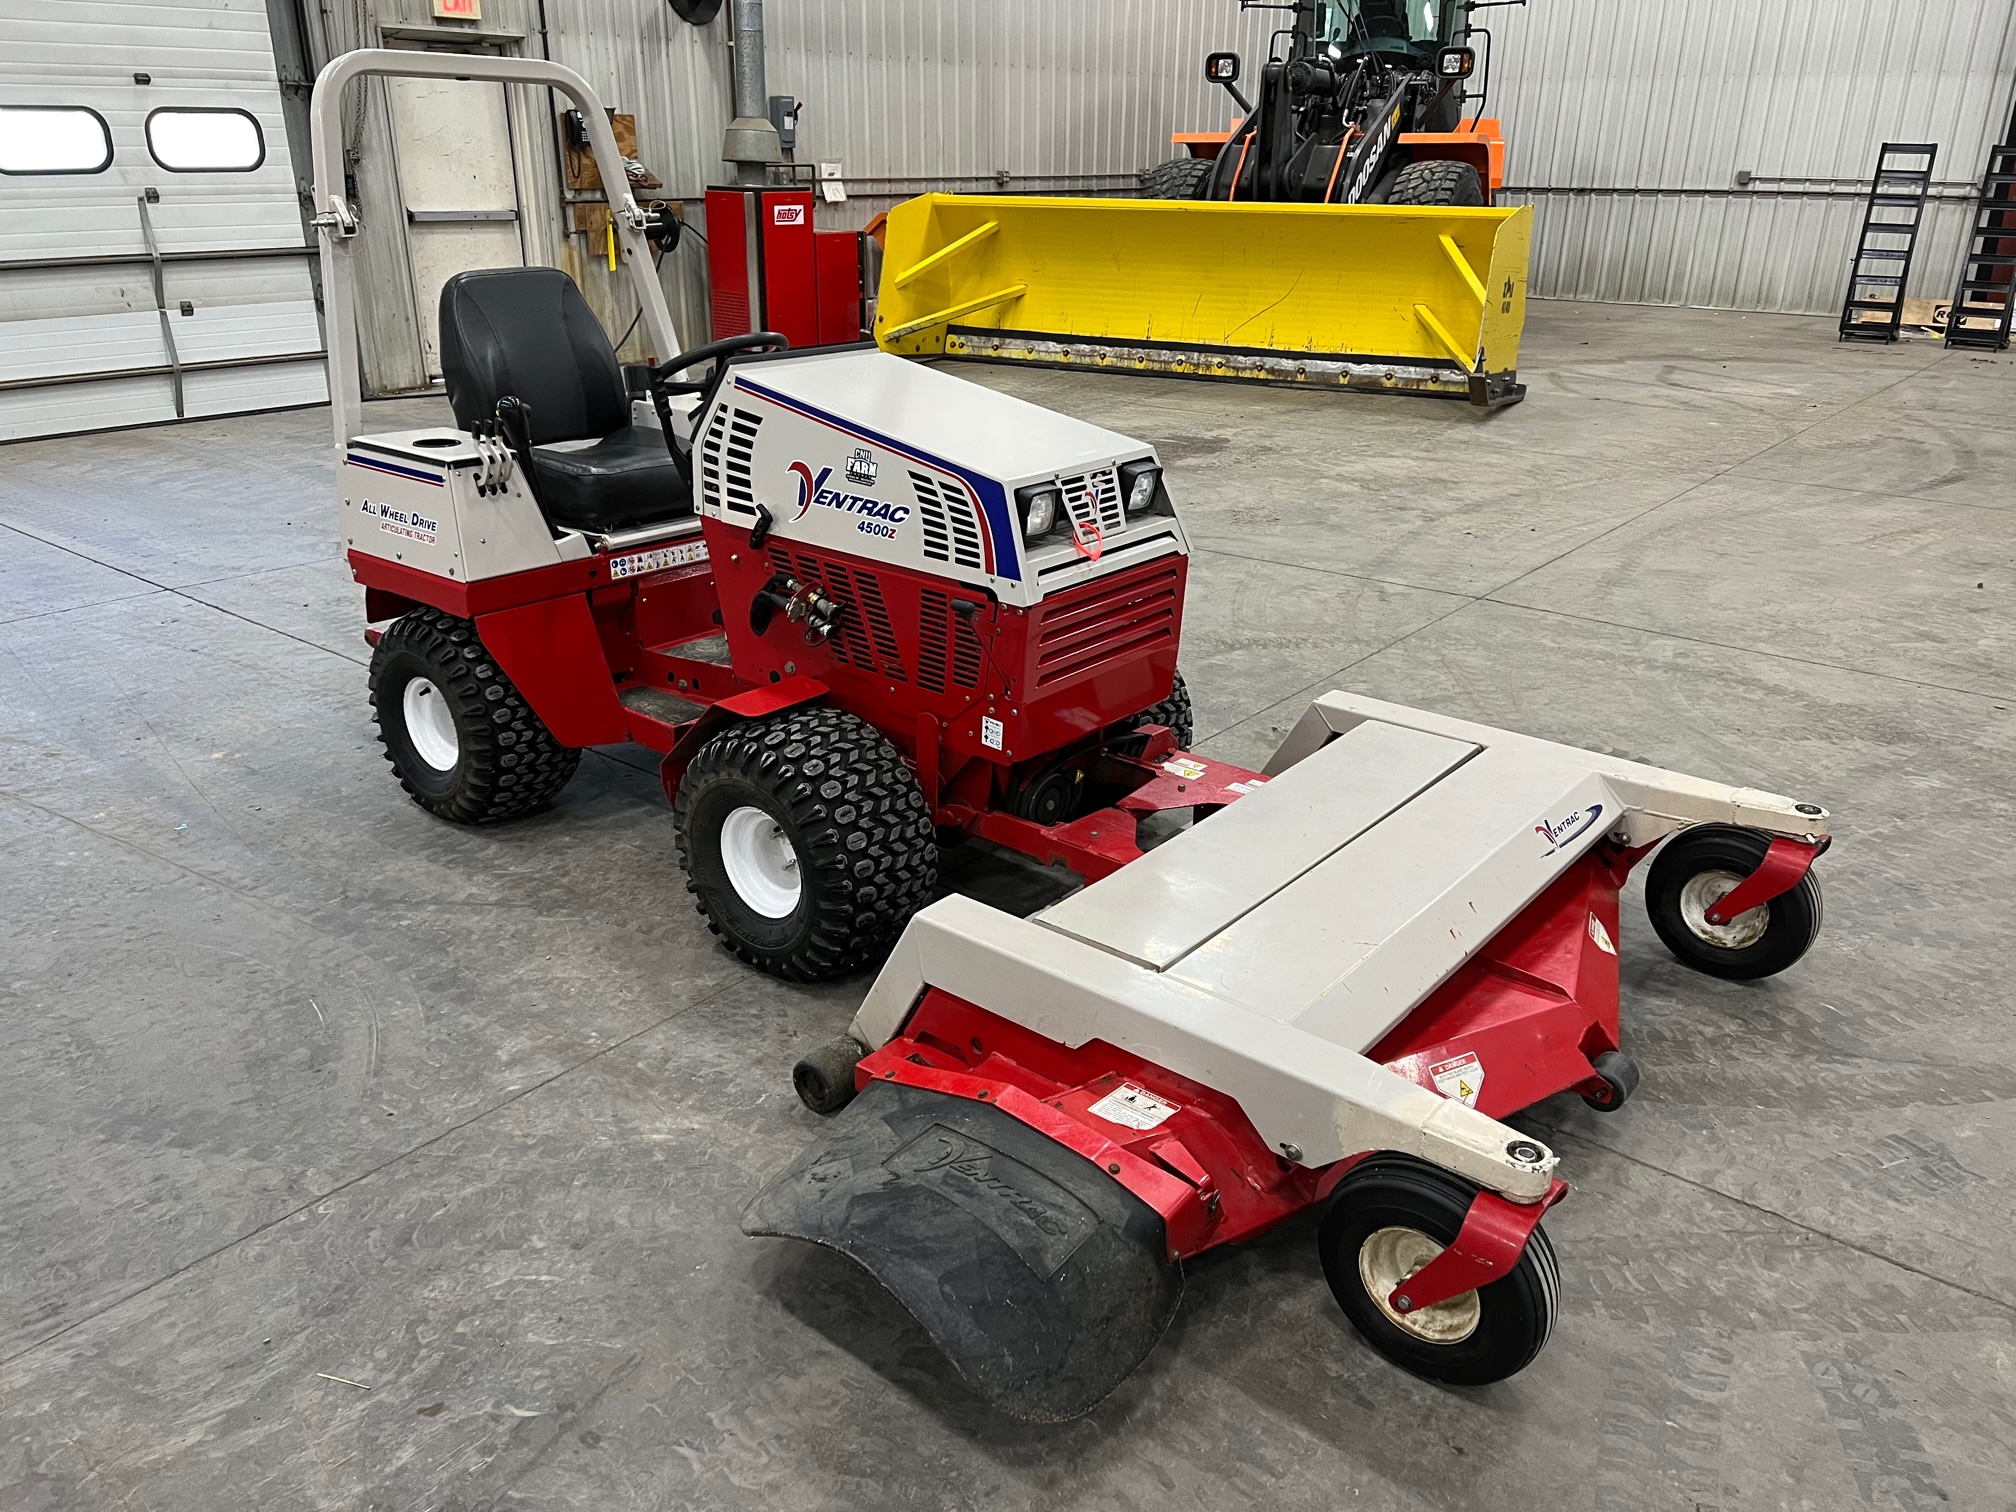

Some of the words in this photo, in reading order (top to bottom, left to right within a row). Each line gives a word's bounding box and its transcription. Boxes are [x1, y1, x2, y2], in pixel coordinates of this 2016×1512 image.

[846, 457, 877, 476] FARM
[787, 461, 911, 523] VENTRAC
[361, 499, 377, 515] ALL
[380, 503, 408, 524] WHEEL
[411, 512, 437, 532] DRIVE
[380, 522, 413, 538] ARTICULATING
[414, 531, 436, 544] TRACTOR
[1535, 811, 1580, 849] VENTRAC
[1444, 1058, 1467, 1071] DANGER
